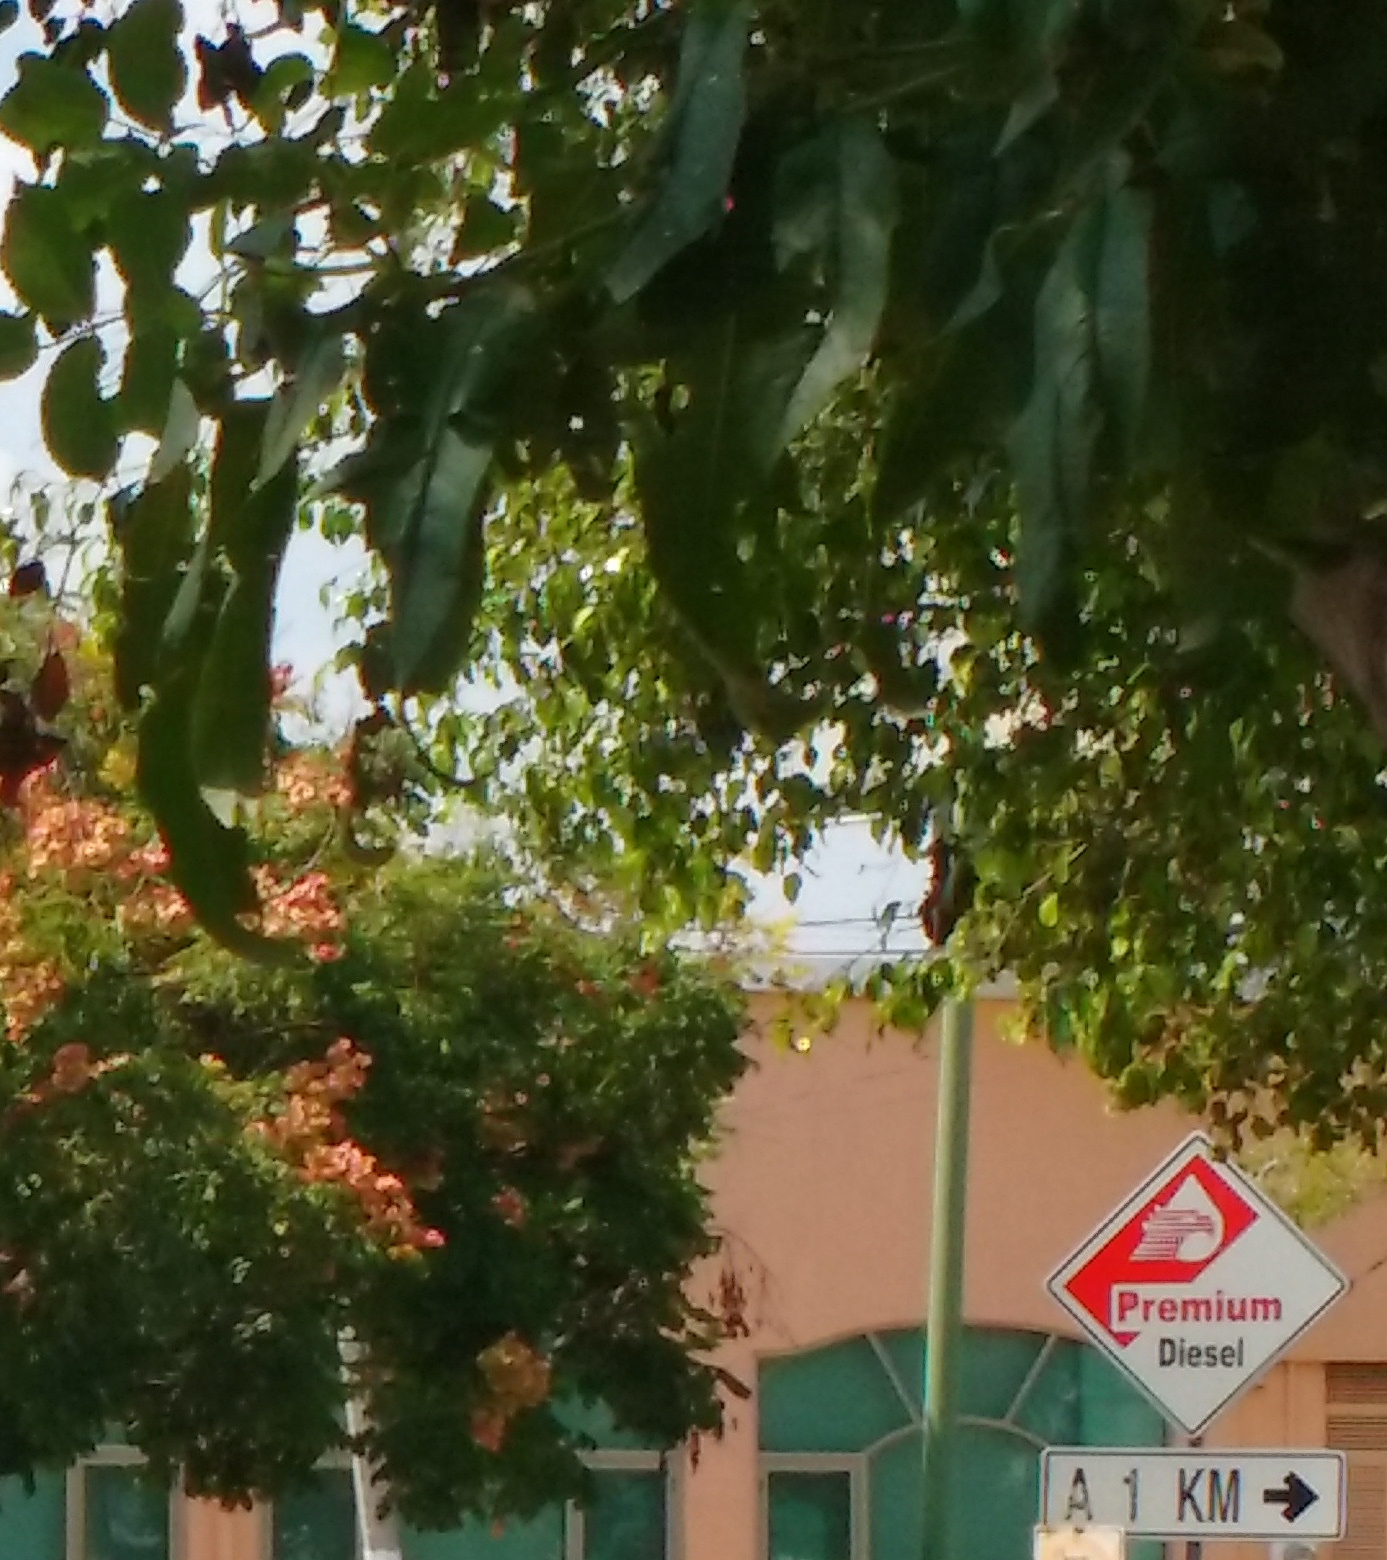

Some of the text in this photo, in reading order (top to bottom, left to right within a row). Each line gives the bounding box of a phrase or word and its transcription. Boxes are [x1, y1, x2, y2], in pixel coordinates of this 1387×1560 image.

[1117, 1290, 1283, 1323] Premium
[1158, 1337, 1246, 1368] Diesel
[1065, 1468, 1241, 1523] A 1 KM
